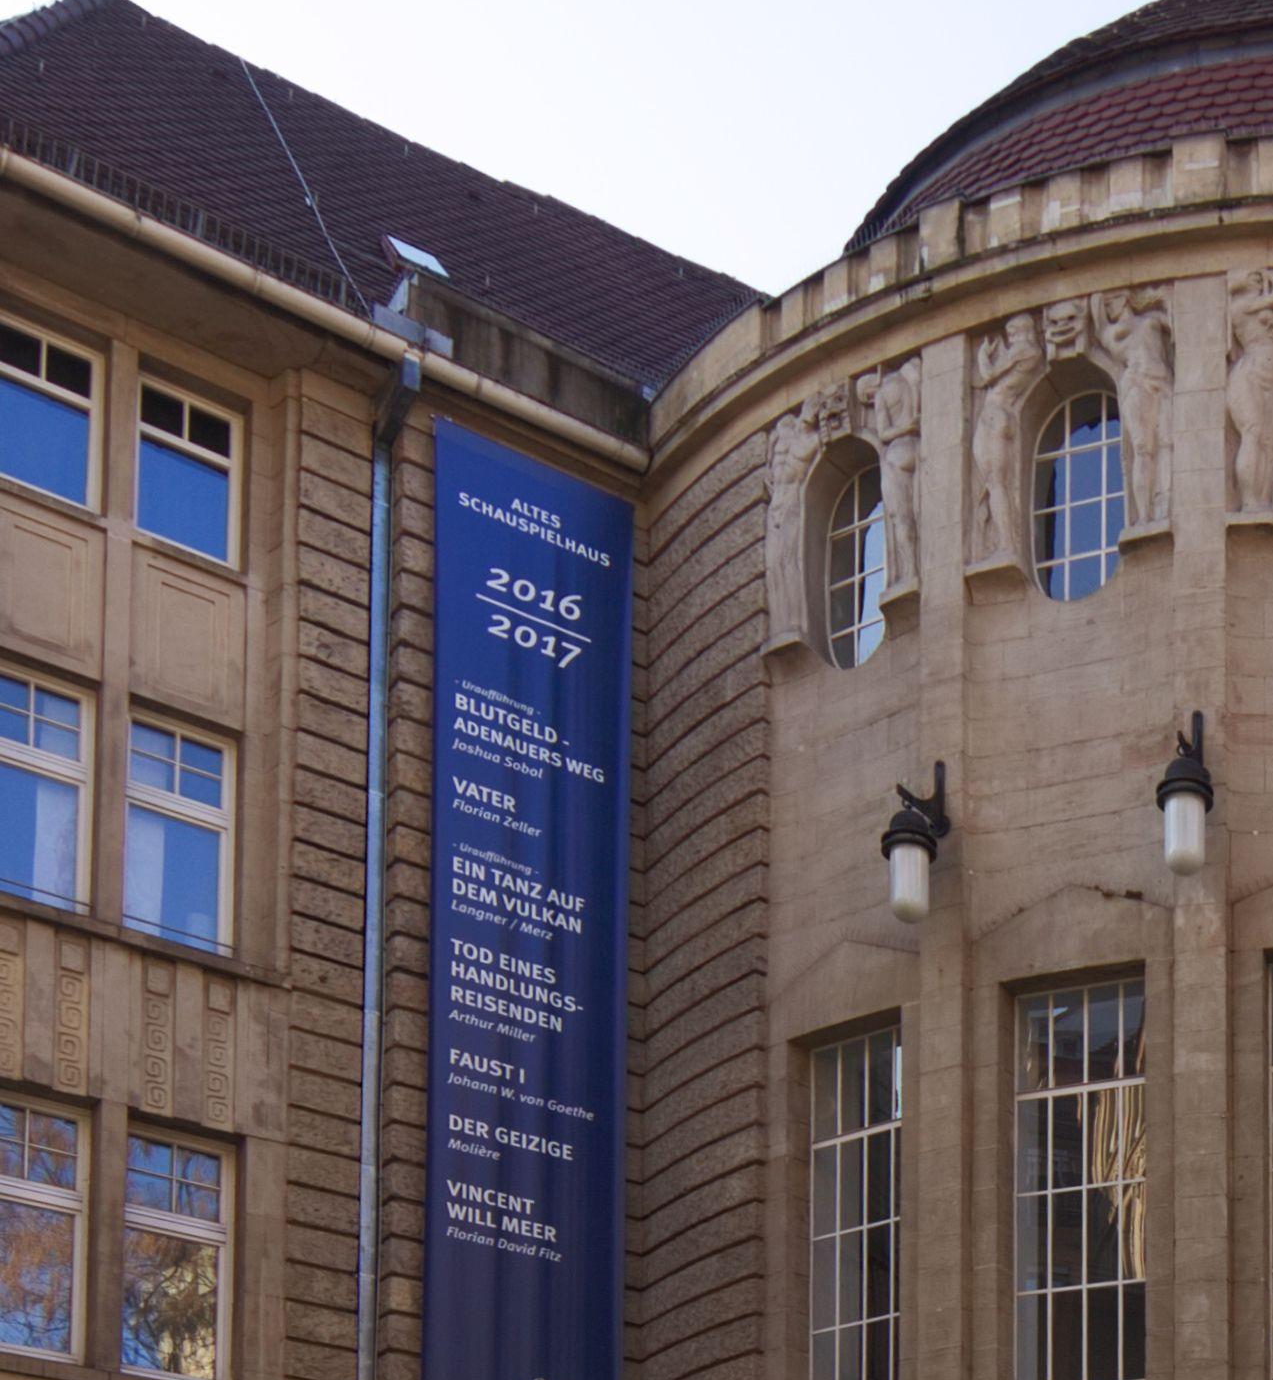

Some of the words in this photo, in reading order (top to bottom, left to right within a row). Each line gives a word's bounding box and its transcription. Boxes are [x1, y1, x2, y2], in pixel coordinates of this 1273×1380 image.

[458, 491, 611, 567] SCHAUSPIELHAUS
[510, 498, 561, 529] ALTES
[486, 568, 582, 621] 2016
[487, 614, 581, 669] 2017
[454, 693, 558, 744] BLUTGELD
[461, 679, 535, 716] Uraufführung
[452, 737, 501, 764] Joshua
[504, 756, 543, 779] Sobol
[453, 717, 562, 768] ADENAUERS
[565, 757, 605, 783] WEG
[452, 776, 517, 813] VATER
[452, 799, 500, 823] Florian
[503, 816, 543, 838] Zeller
[460, 842, 533, 875] Uraufführung
[452, 856, 486, 882] EIN
[491, 869, 543, 900] TANZ
[547, 889, 586, 913] AUF
[451, 900, 508, 927] Langner
[519, 923, 554, 941] Merz
[452, 878, 498, 907] DEM
[502, 895, 583, 934] VULKAN
[450, 938, 493, 965] TOD
[499, 954, 556, 984] EINES
[451, 961, 584, 1013] HANDLUNGS-
[448, 1009, 494, 1031] Arthur
[497, 1022, 536, 1043] Miller
[450, 986, 563, 1033] REISENDEN
[450, 1048, 514, 1080] FAUST
[519, 1067, 526, 1084] I
[447, 1073, 497, 1095] Johann
[501, 1086, 516, 1101] W.
[519, 1095, 545, 1108] von
[547, 1100, 595, 1122] Goethe
[447, 1138, 500, 1161] Molière
[448, 1114, 489, 1139] DER
[495, 1127, 574, 1161] GEIZIGE
[446, 1179, 535, 1215] VINCENT
[446, 1201, 497, 1228] WILL
[501, 1217, 557, 1243] MEER
[446, 1226, 495, 1247] Florian
[497, 1238, 536, 1256] David
[538, 1247, 562, 1263] Fitz
